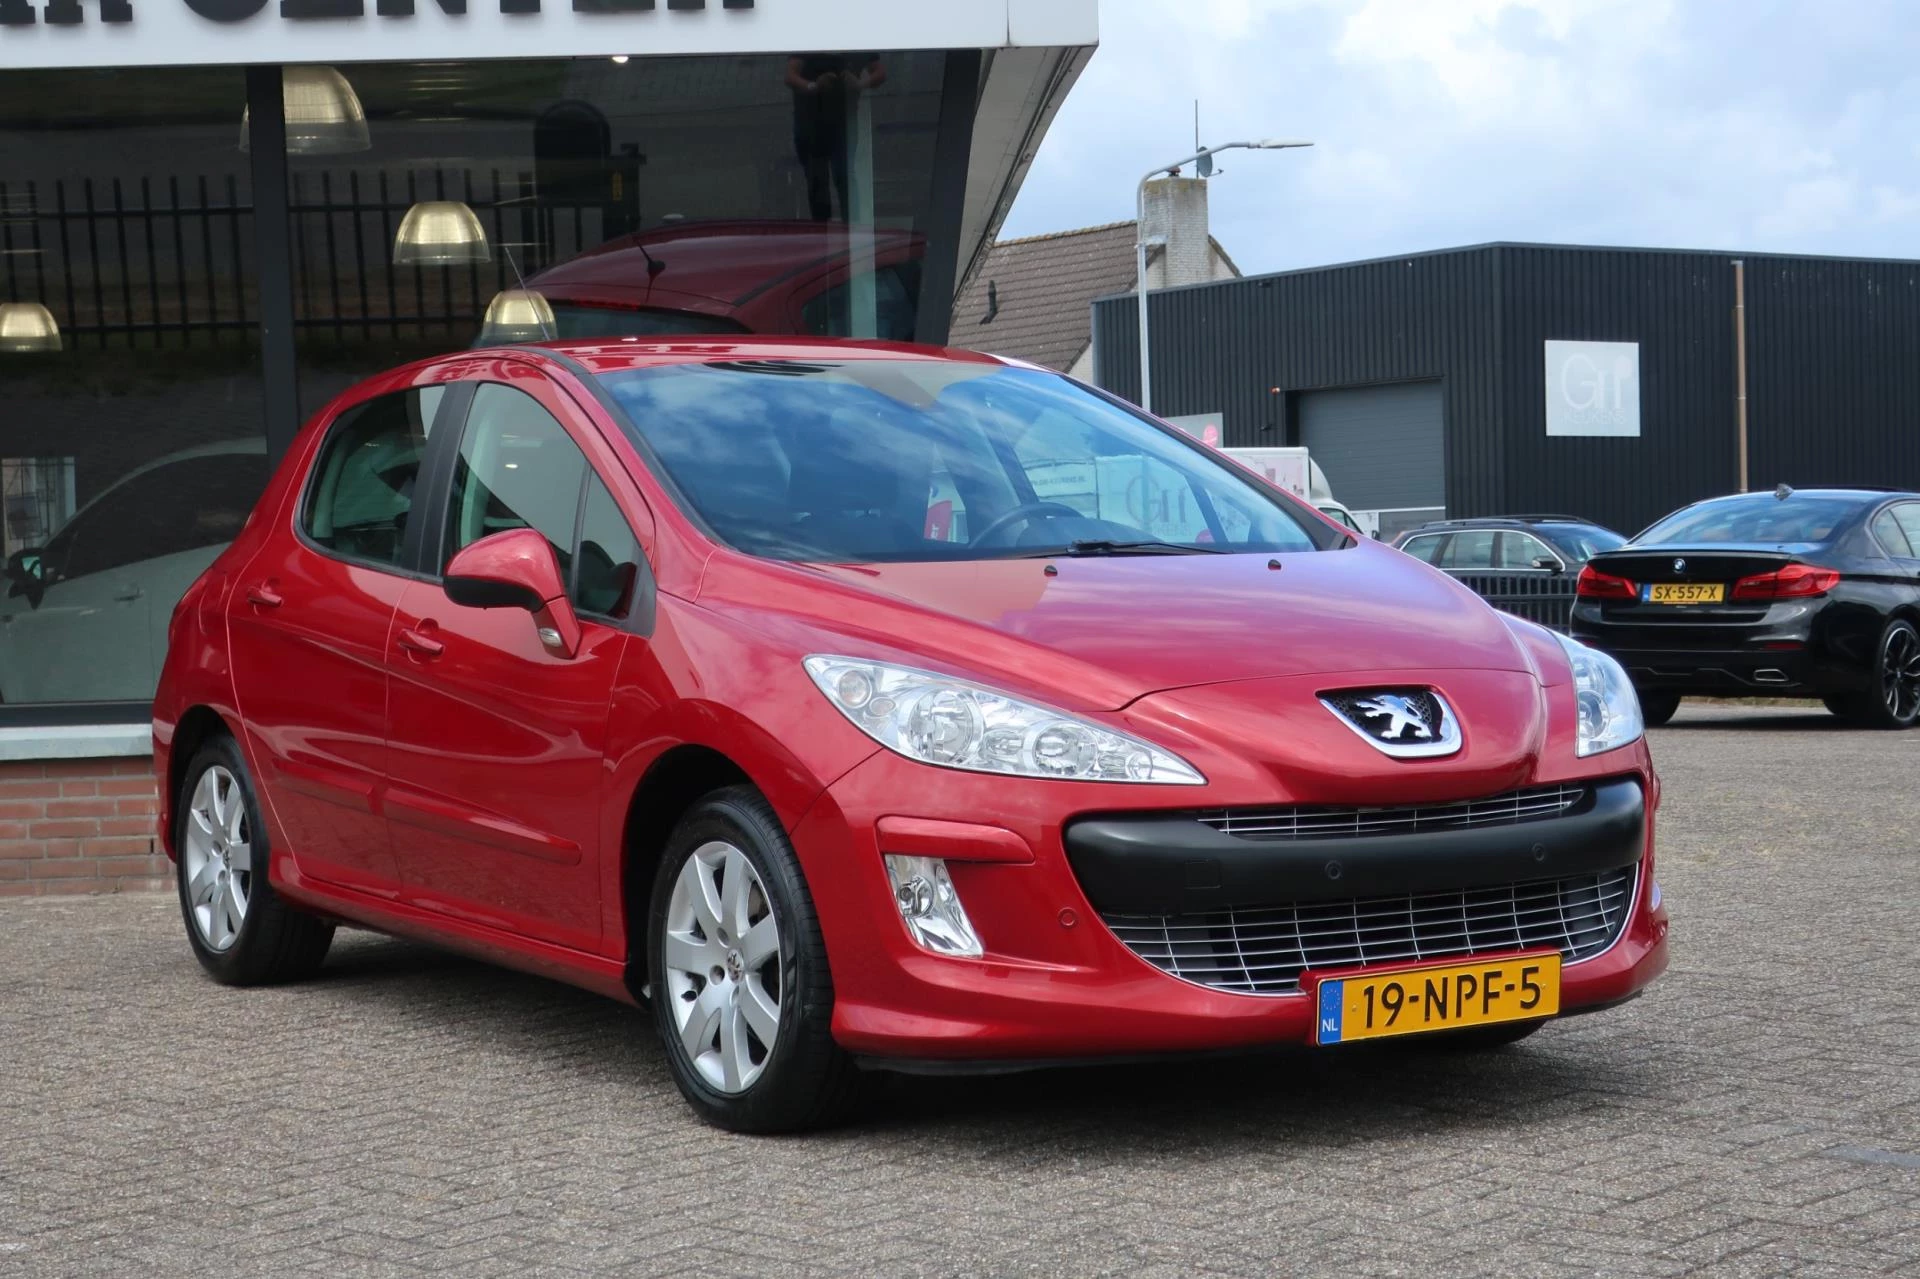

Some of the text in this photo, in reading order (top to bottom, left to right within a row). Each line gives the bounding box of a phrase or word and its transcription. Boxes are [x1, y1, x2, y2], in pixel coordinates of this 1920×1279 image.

[1654, 586, 1717, 599] SX-557-X
[1363, 966, 1541, 1029] 19-NPF-5
[1322, 1018, 1339, 1033] NL
